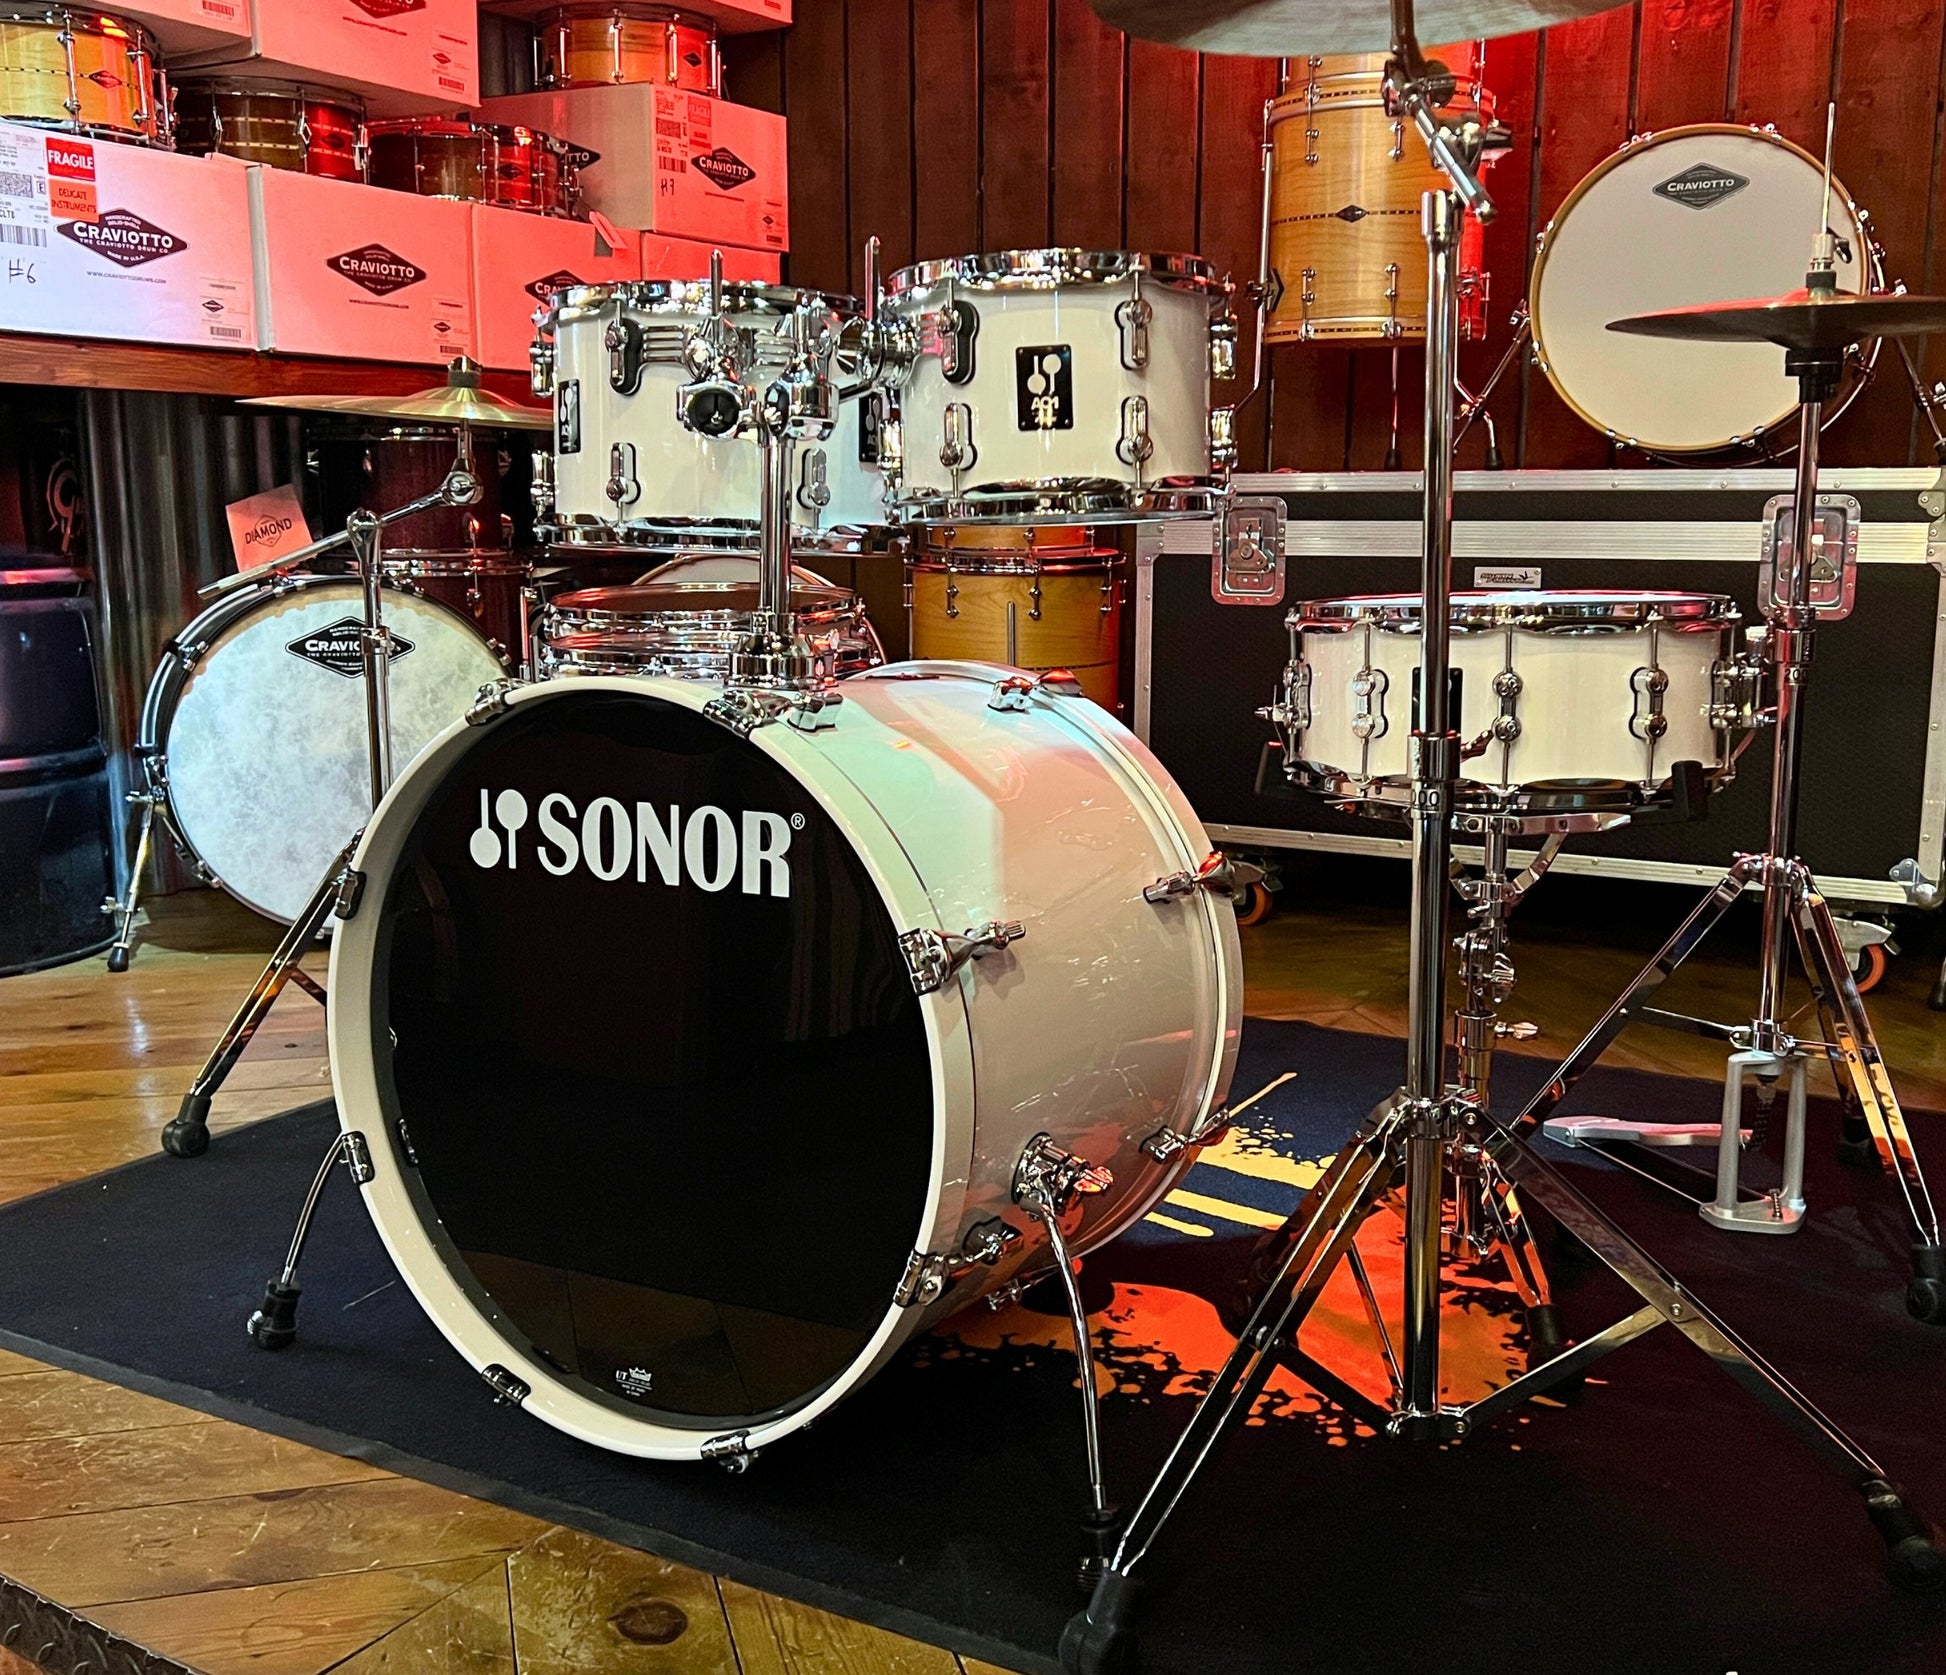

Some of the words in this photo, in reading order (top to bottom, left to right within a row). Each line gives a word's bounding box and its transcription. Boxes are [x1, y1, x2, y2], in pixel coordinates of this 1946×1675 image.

[47, 149, 94, 170] FRAGILE
[699, 156, 749, 177] CRAVIOTTO
[58, 187, 87, 200] DELICATE
[1667, 178, 1735, 192] CRAVIOTTO
[73, 221, 174, 249] CRAVIOTTO
[339, 256, 415, 278] CRAVIOTTO
[244, 517, 293, 545] DIAMOND
[305, 639, 361, 652] CRAVIO
